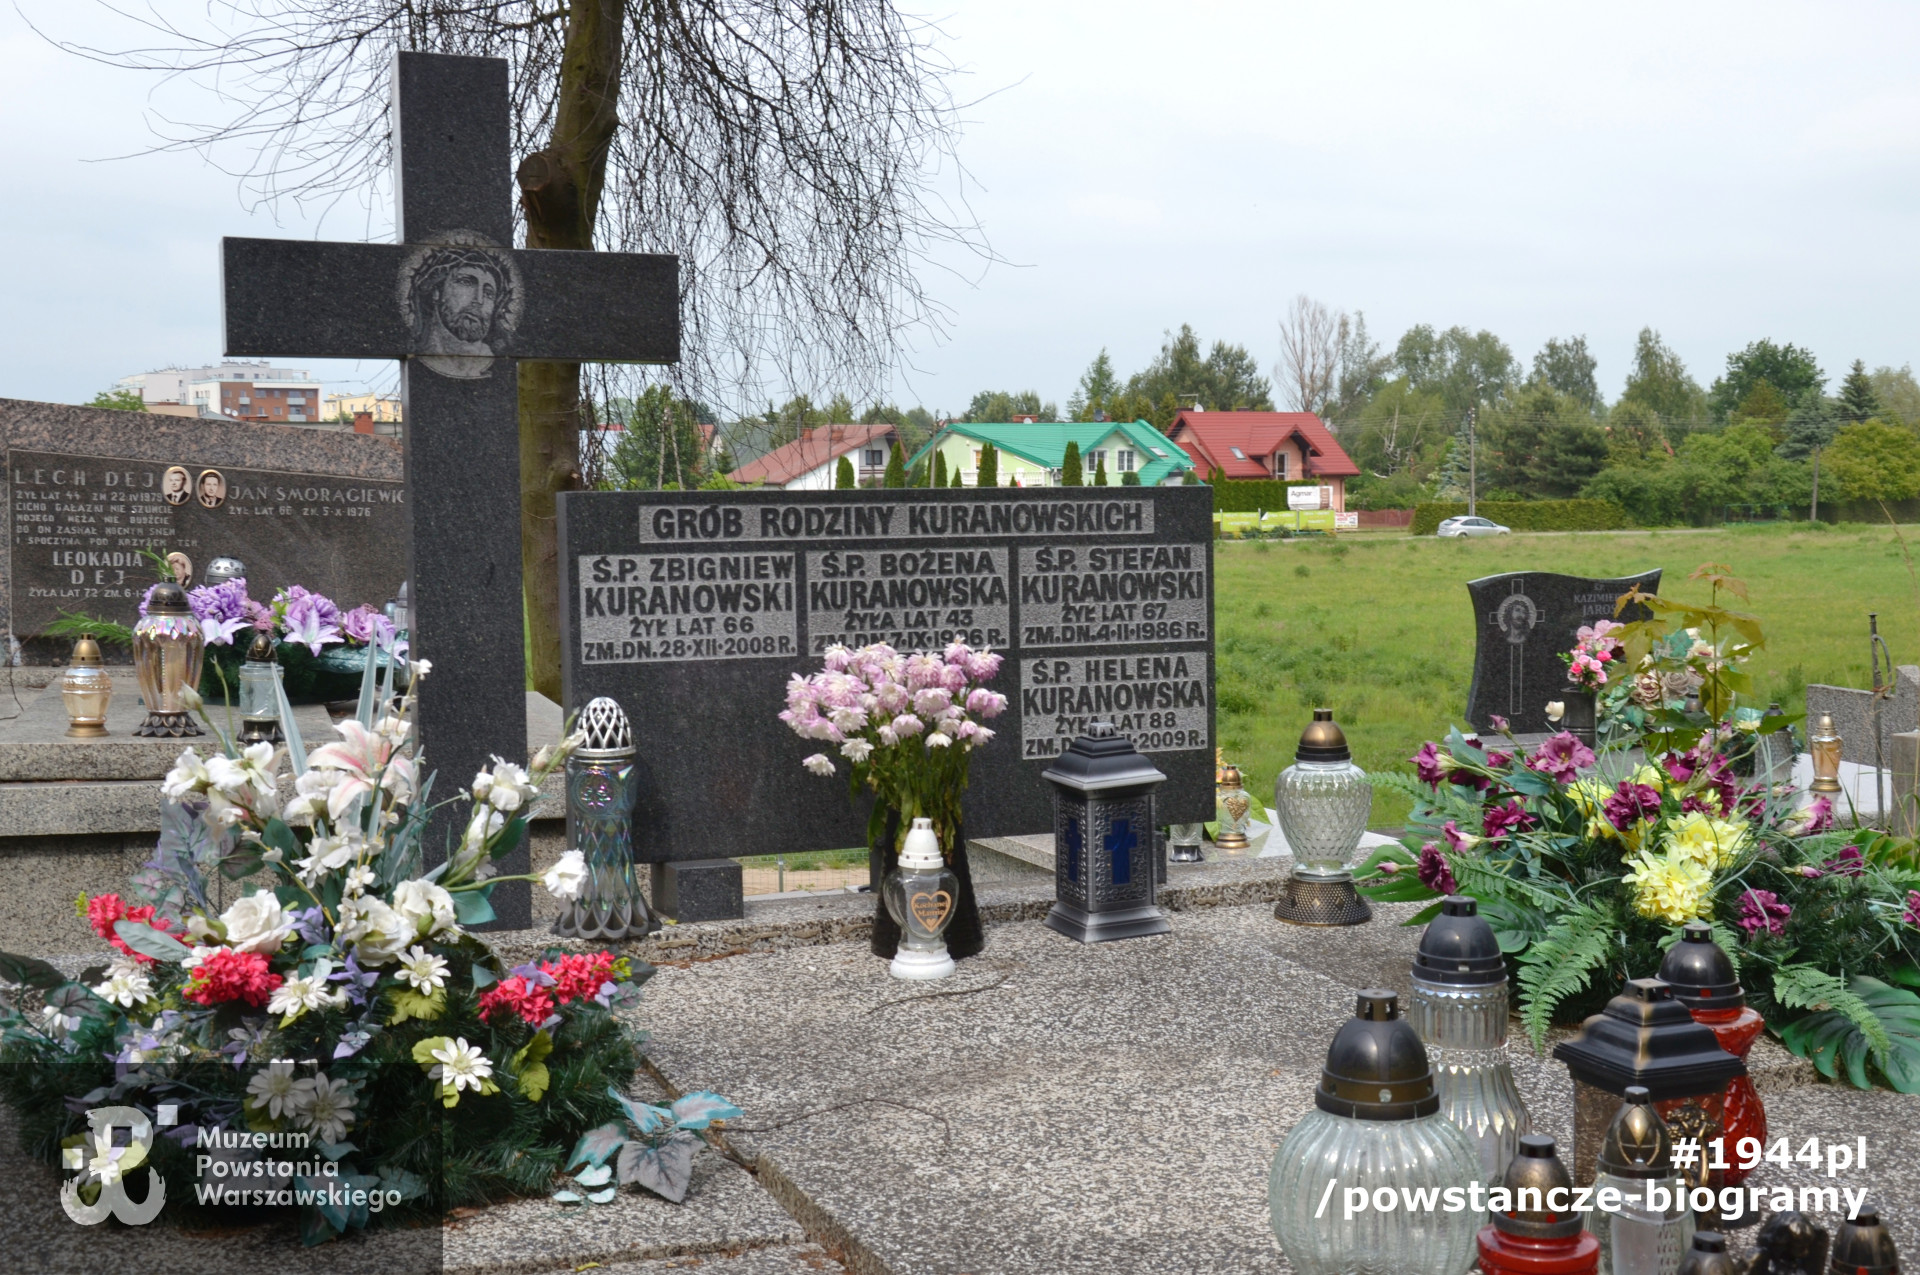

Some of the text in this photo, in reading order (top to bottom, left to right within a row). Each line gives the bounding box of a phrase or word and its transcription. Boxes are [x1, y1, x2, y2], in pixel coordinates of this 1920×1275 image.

[15, 469, 154, 488] LECH DEJ
[41, 491, 60, 501] LAT
[228, 485, 268, 500] JAN
[103, 515, 120, 524] NIE
[110, 504, 127, 513] NIE
[254, 507, 275, 516] LAT
[652, 502, 1143, 539] GRÓB RODZINY KURANOWSKICH
[52, 551, 143, 567] LEOKADIA
[592, 555, 794, 583] Ś.P. ZBIGNIEW
[821, 548, 996, 578] Ś.P. BOŻENA
[1035, 546, 1191, 572] Ś.P. STEFAN
[71, 569, 125, 585] DEJ
[1021, 571, 1203, 604] KURANOWSKI
[60, 589, 81, 598] LAT
[83, 588, 98, 598] 72
[585, 582, 793, 617] KURANOWSKI
[810, 576, 1008, 611] KURANOWSKA
[844, 608, 974, 631] ŻYŁA LAT 43
[1061, 601, 1167, 623] ŻYŁ LAT 67
[630, 616, 755, 638] ŻYŁ LAT 66
[1031, 656, 1189, 684] Ś.P. HELENA
[1023, 680, 1206, 716] KURANOWSKA
[1150, 711, 1176, 728] 88
